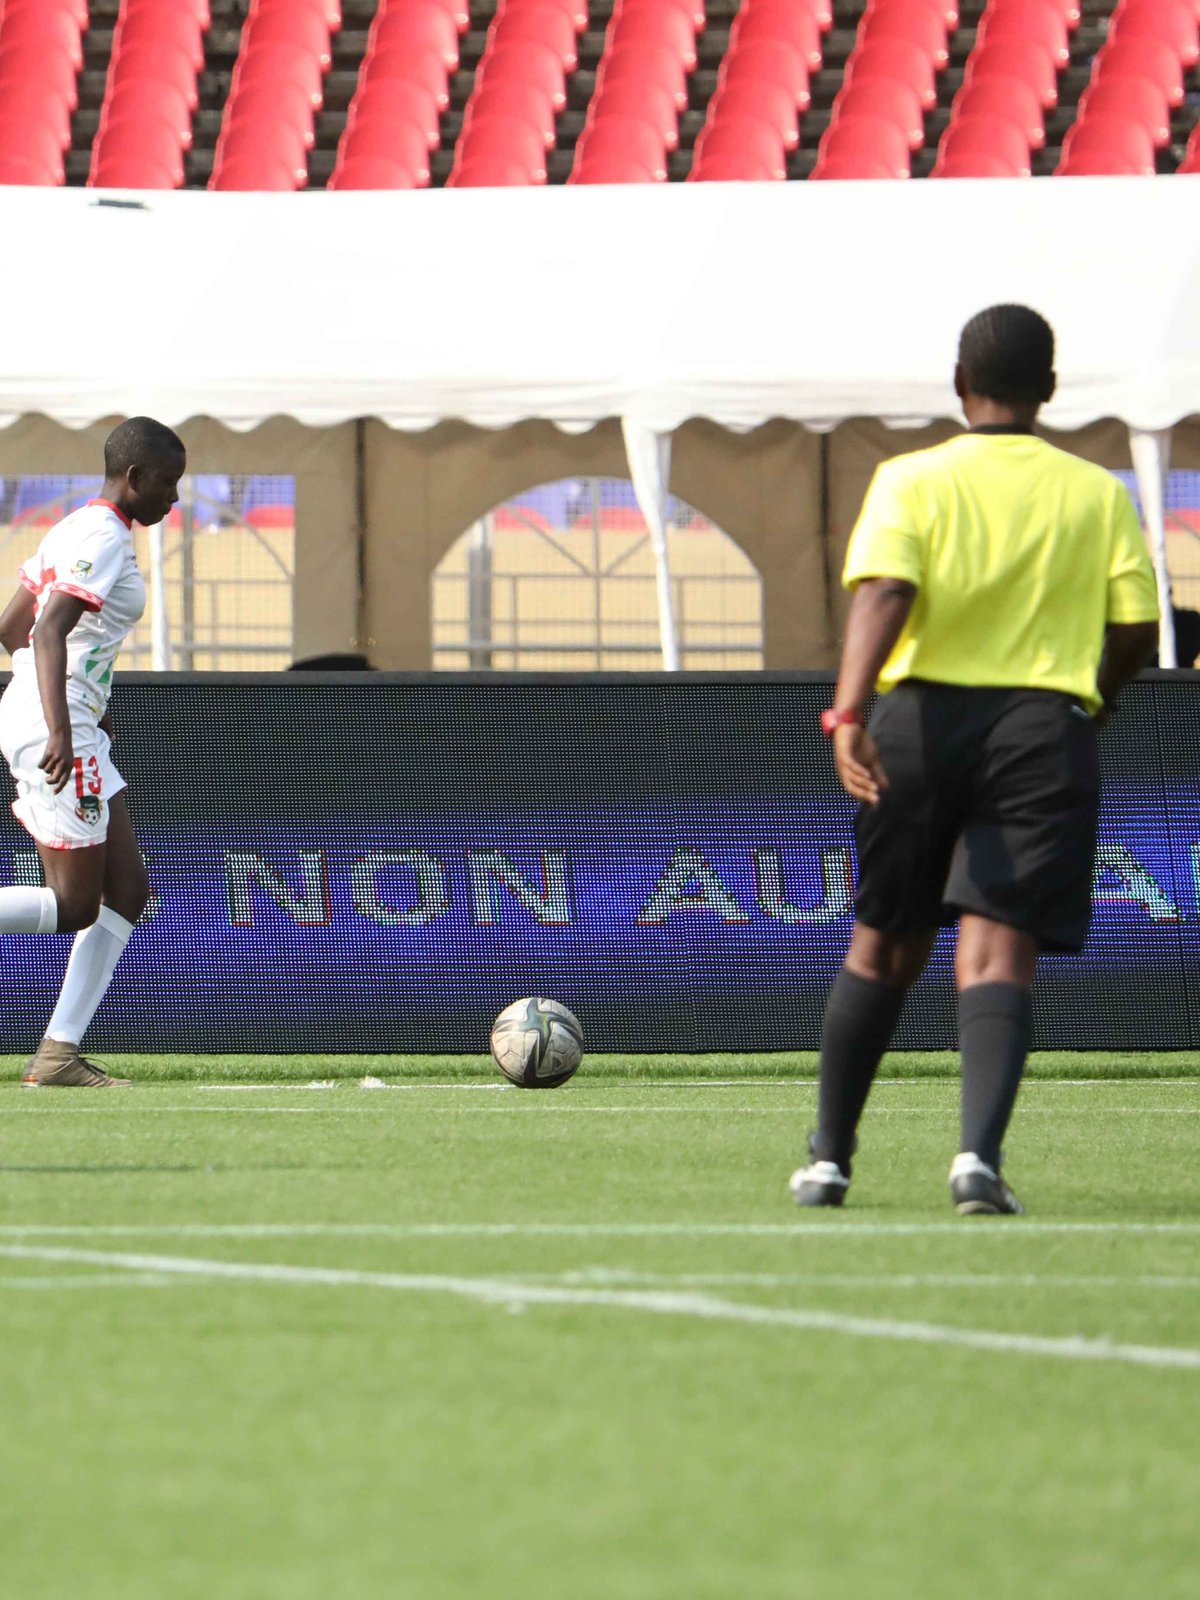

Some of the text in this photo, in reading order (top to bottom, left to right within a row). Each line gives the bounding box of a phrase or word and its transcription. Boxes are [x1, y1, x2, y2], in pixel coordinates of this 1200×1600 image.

[73, 755, 103, 799] 13
[224, 849, 576, 927] NON
[635, 847, 854, 926] AU
